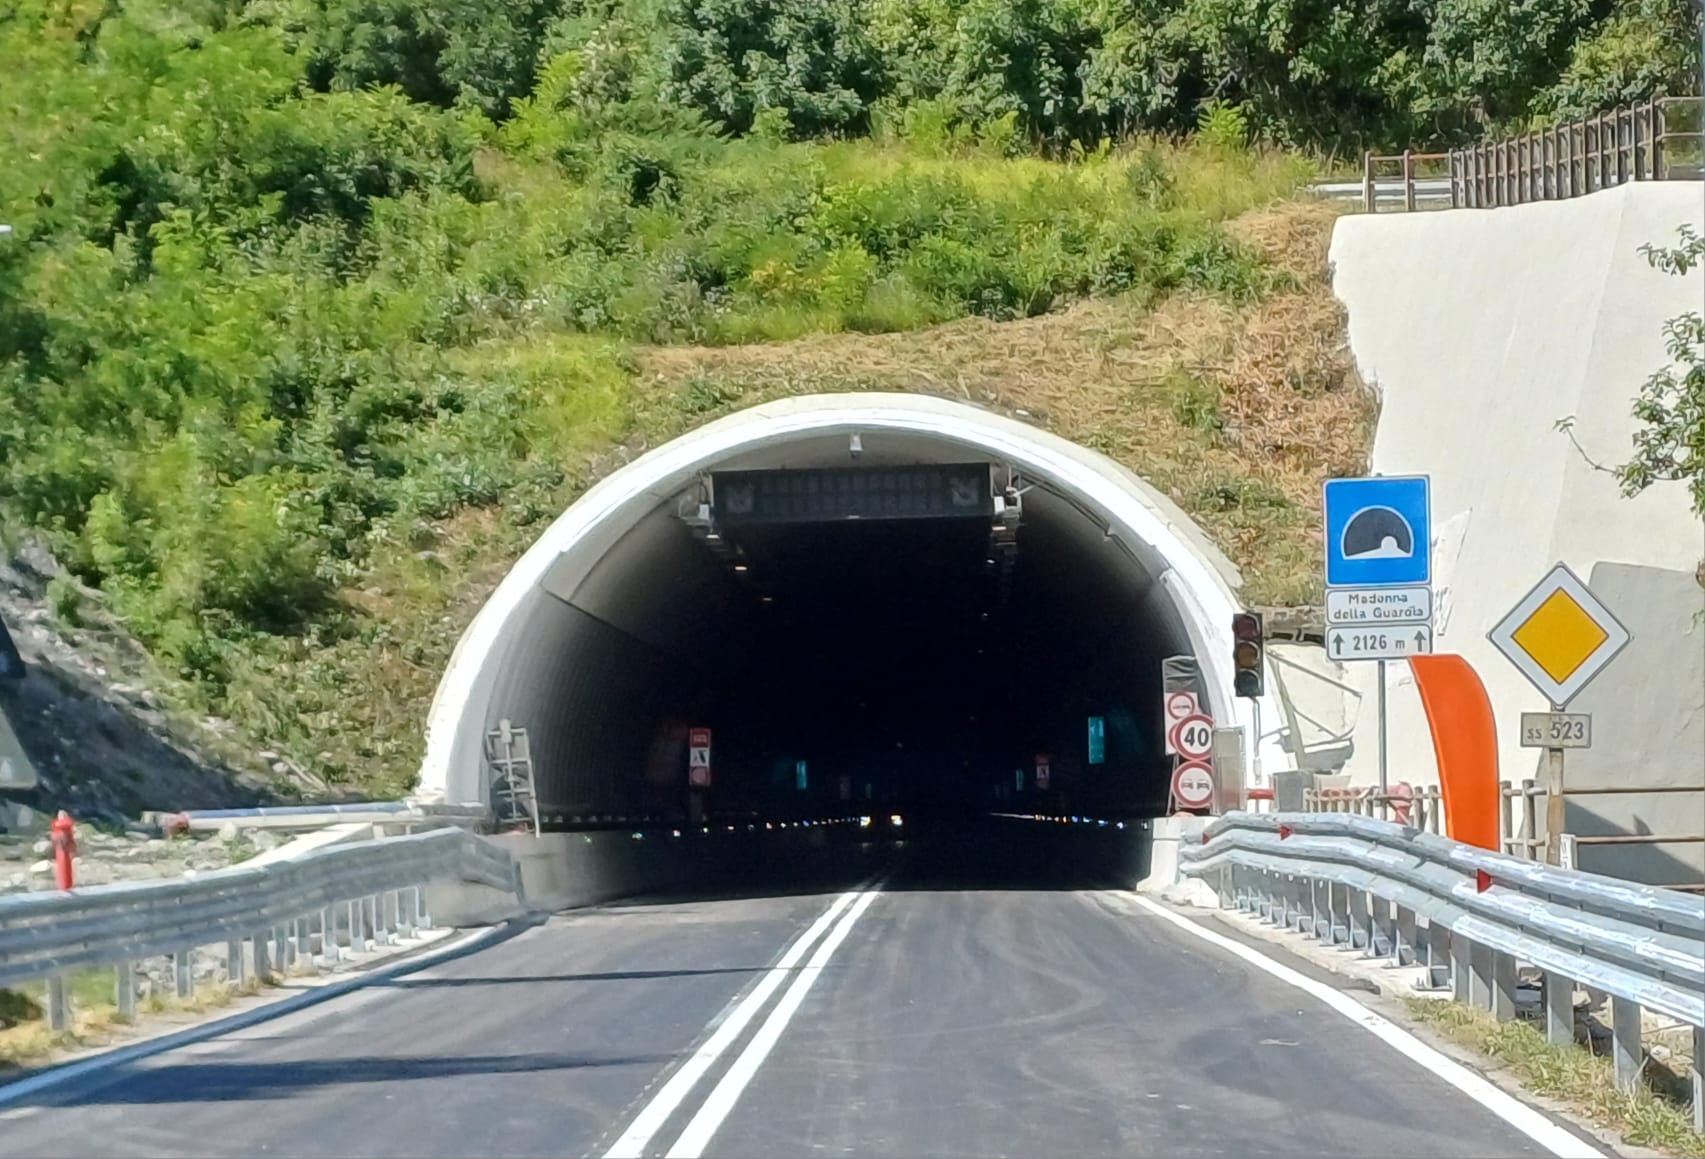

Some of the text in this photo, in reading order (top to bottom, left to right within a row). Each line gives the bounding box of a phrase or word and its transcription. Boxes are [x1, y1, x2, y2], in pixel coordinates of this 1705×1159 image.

[1349, 594, 1408, 604] Madonna
[1334, 609, 1366, 619] della
[1353, 635, 1405, 650] 2126 m
[1184, 727, 1208, 746] 40
[1550, 721, 1584, 739] 523
